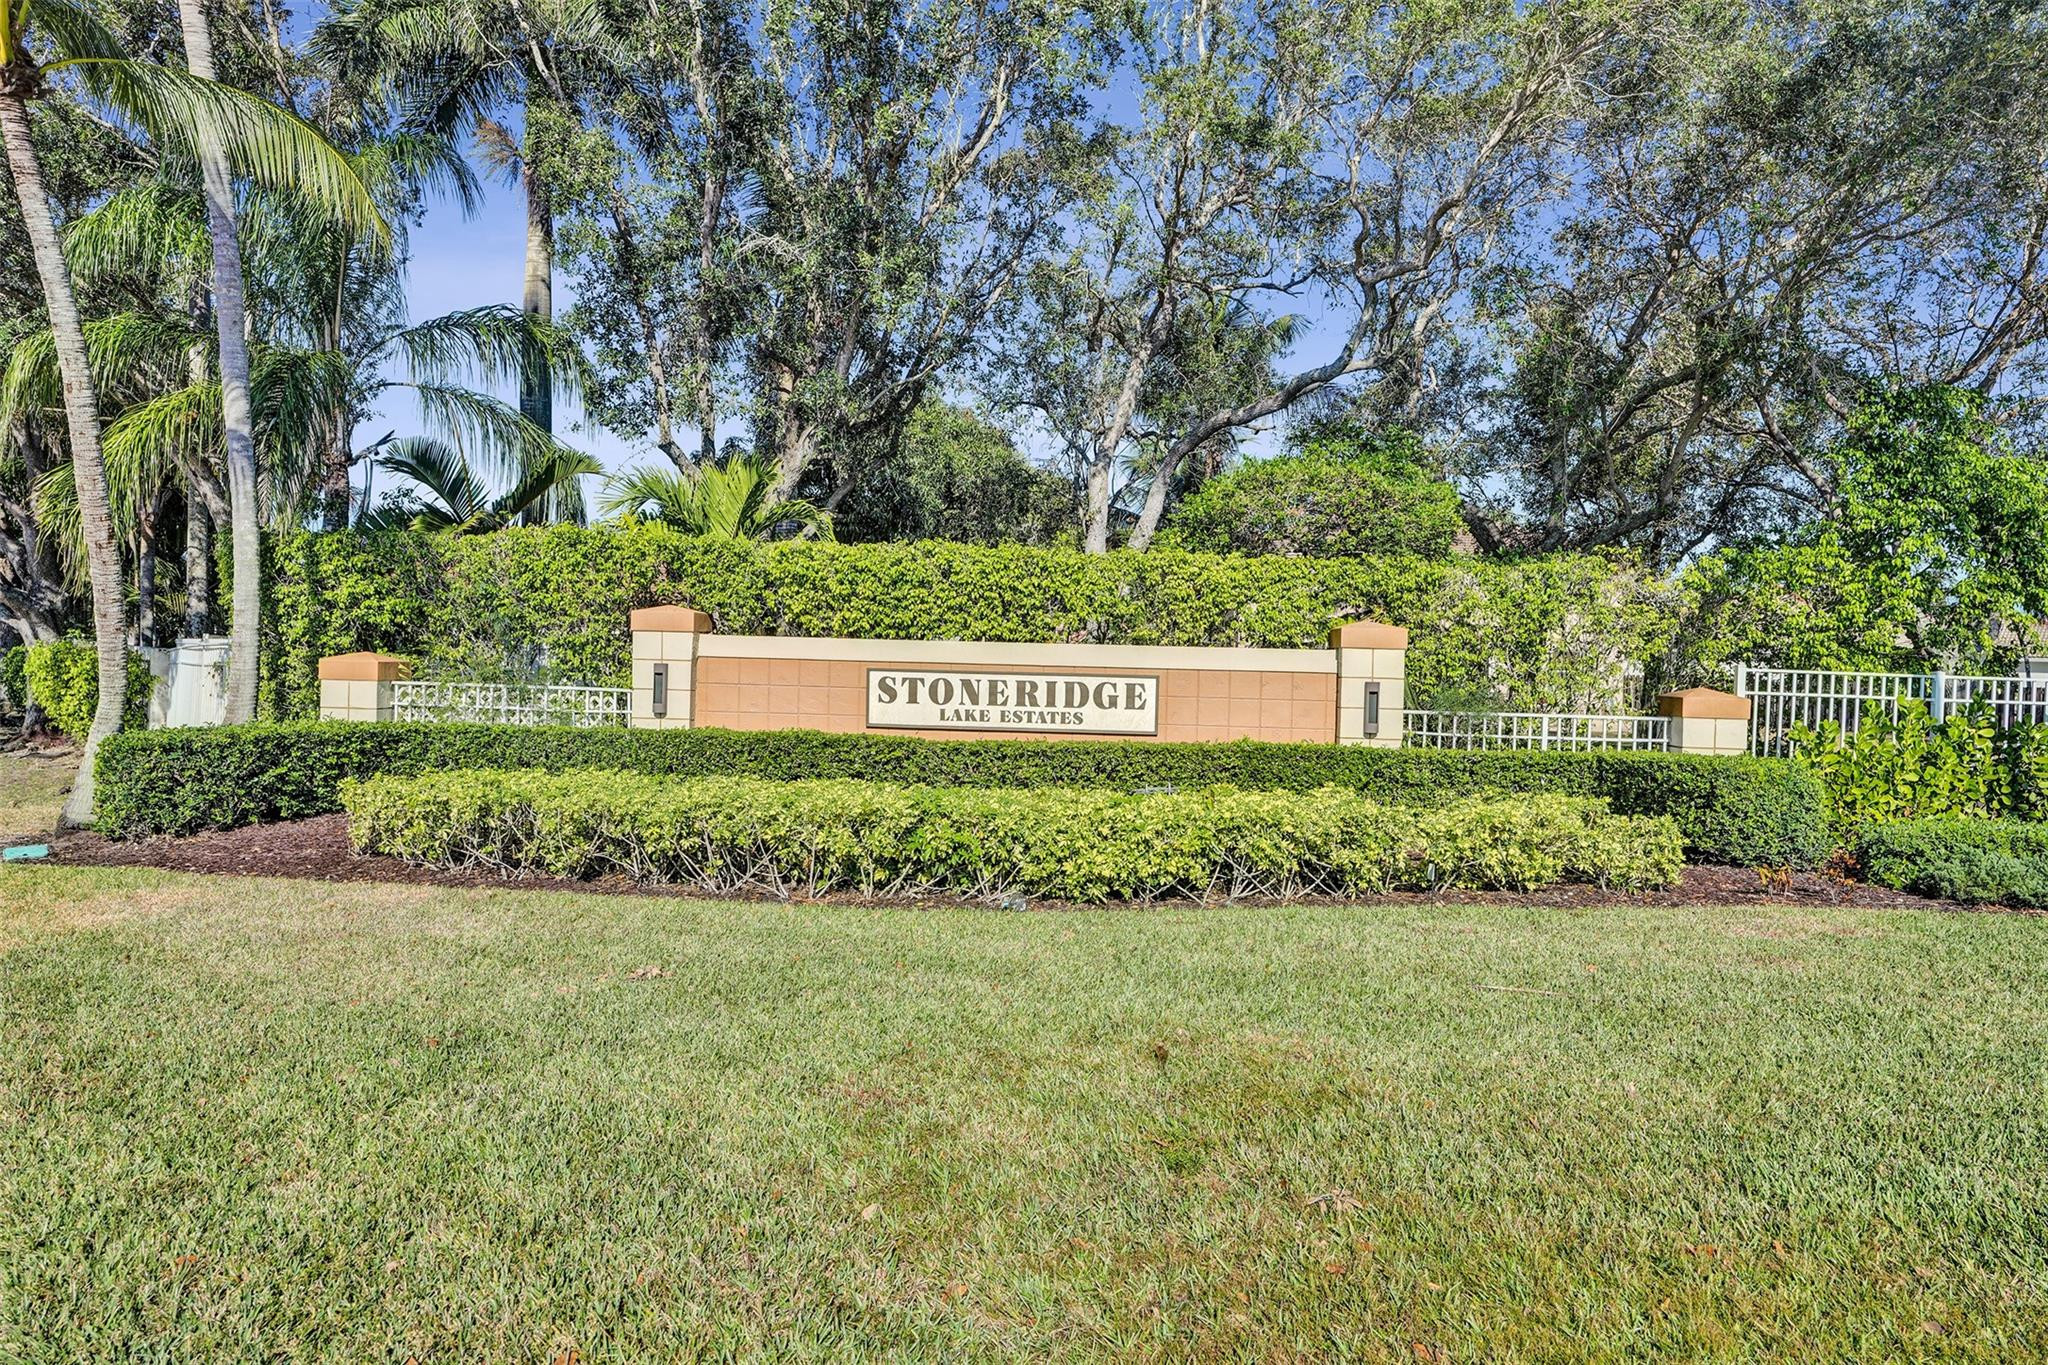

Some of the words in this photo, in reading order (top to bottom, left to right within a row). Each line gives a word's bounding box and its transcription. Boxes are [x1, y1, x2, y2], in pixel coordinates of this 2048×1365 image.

[878, 676, 1147, 710] STONERIDGE
[939, 708, 991, 722] LAKE
[1000, 710, 1084, 725] ESTATES
